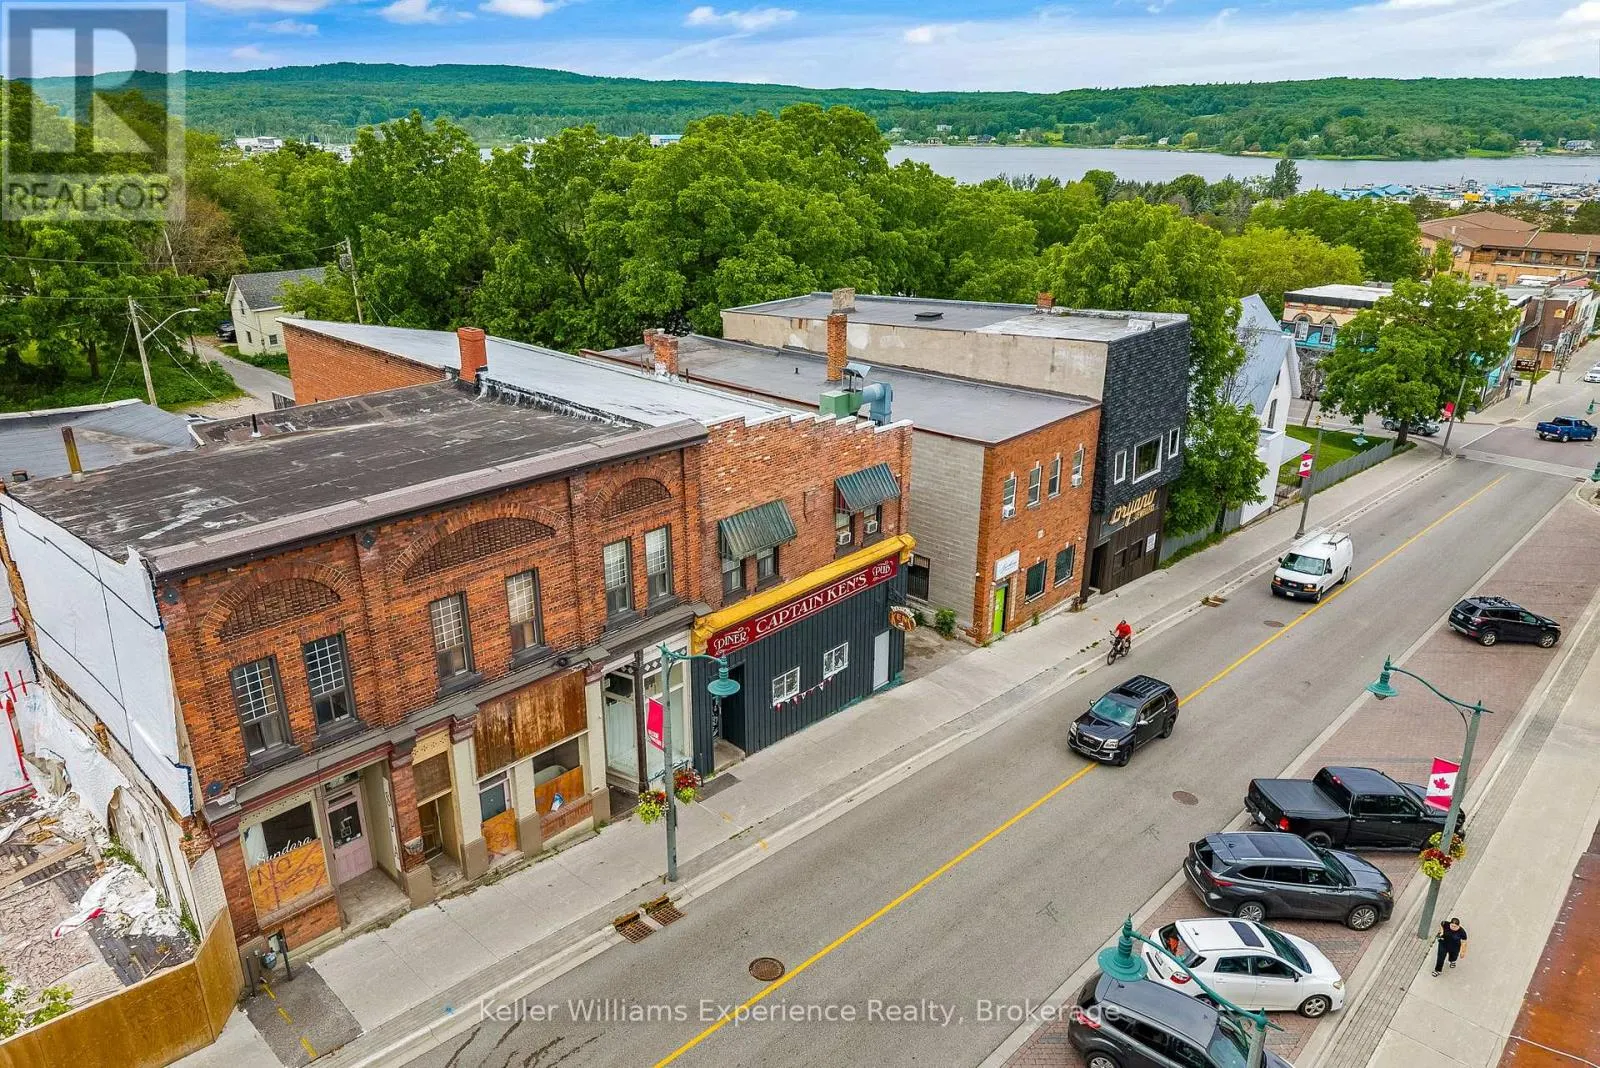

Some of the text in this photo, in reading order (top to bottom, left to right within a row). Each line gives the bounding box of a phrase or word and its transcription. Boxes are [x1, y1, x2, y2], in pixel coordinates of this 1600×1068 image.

[755, 572, 868, 634] CAPTAIN KEN'S
[714, 631, 750, 651] DINER
[257, 837, 312, 865] Sundara
